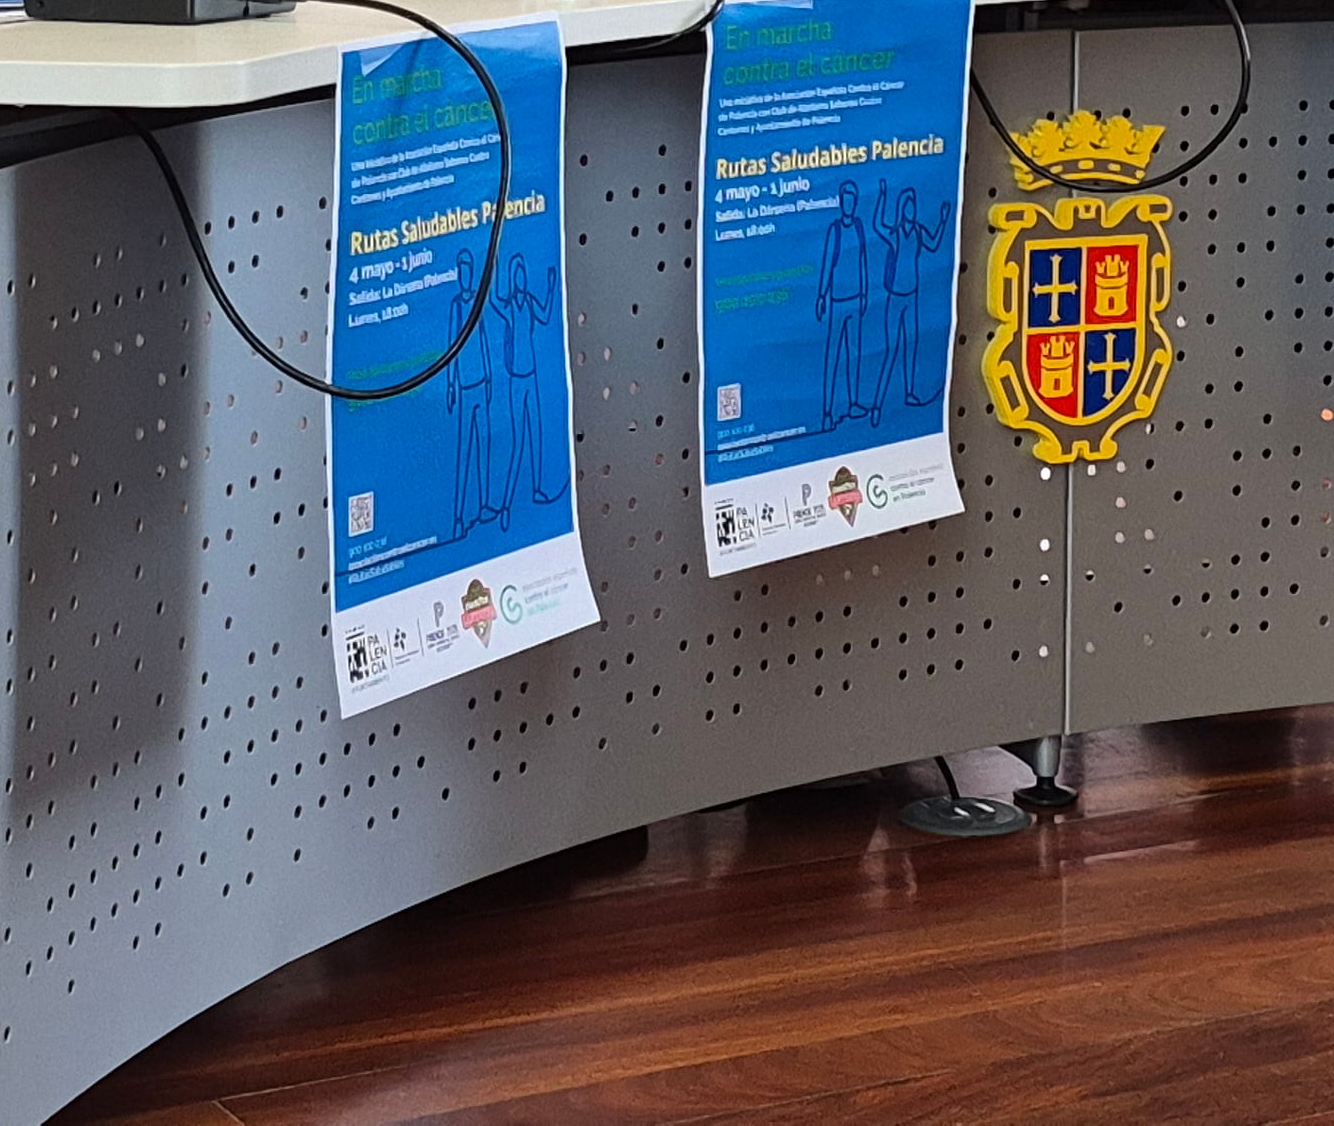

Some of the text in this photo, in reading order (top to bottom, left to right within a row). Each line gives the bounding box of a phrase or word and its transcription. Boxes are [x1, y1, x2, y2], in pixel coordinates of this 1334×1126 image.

[715, 133, 945, 180] Rutas Saludables Palencia
[714, 189, 723, 204] 4
[725, 184, 760, 203] mayo
[770, 182, 778, 195] 1
[777, 175, 811, 198] junio
[350, 227, 399, 256] Rutas
[401, 205, 479, 245] Saludables
[348, 266, 359, 284] 4
[361, 260, 394, 282] mayo
[401, 256, 408, 271] 1
[408, 247, 433, 274] junio
